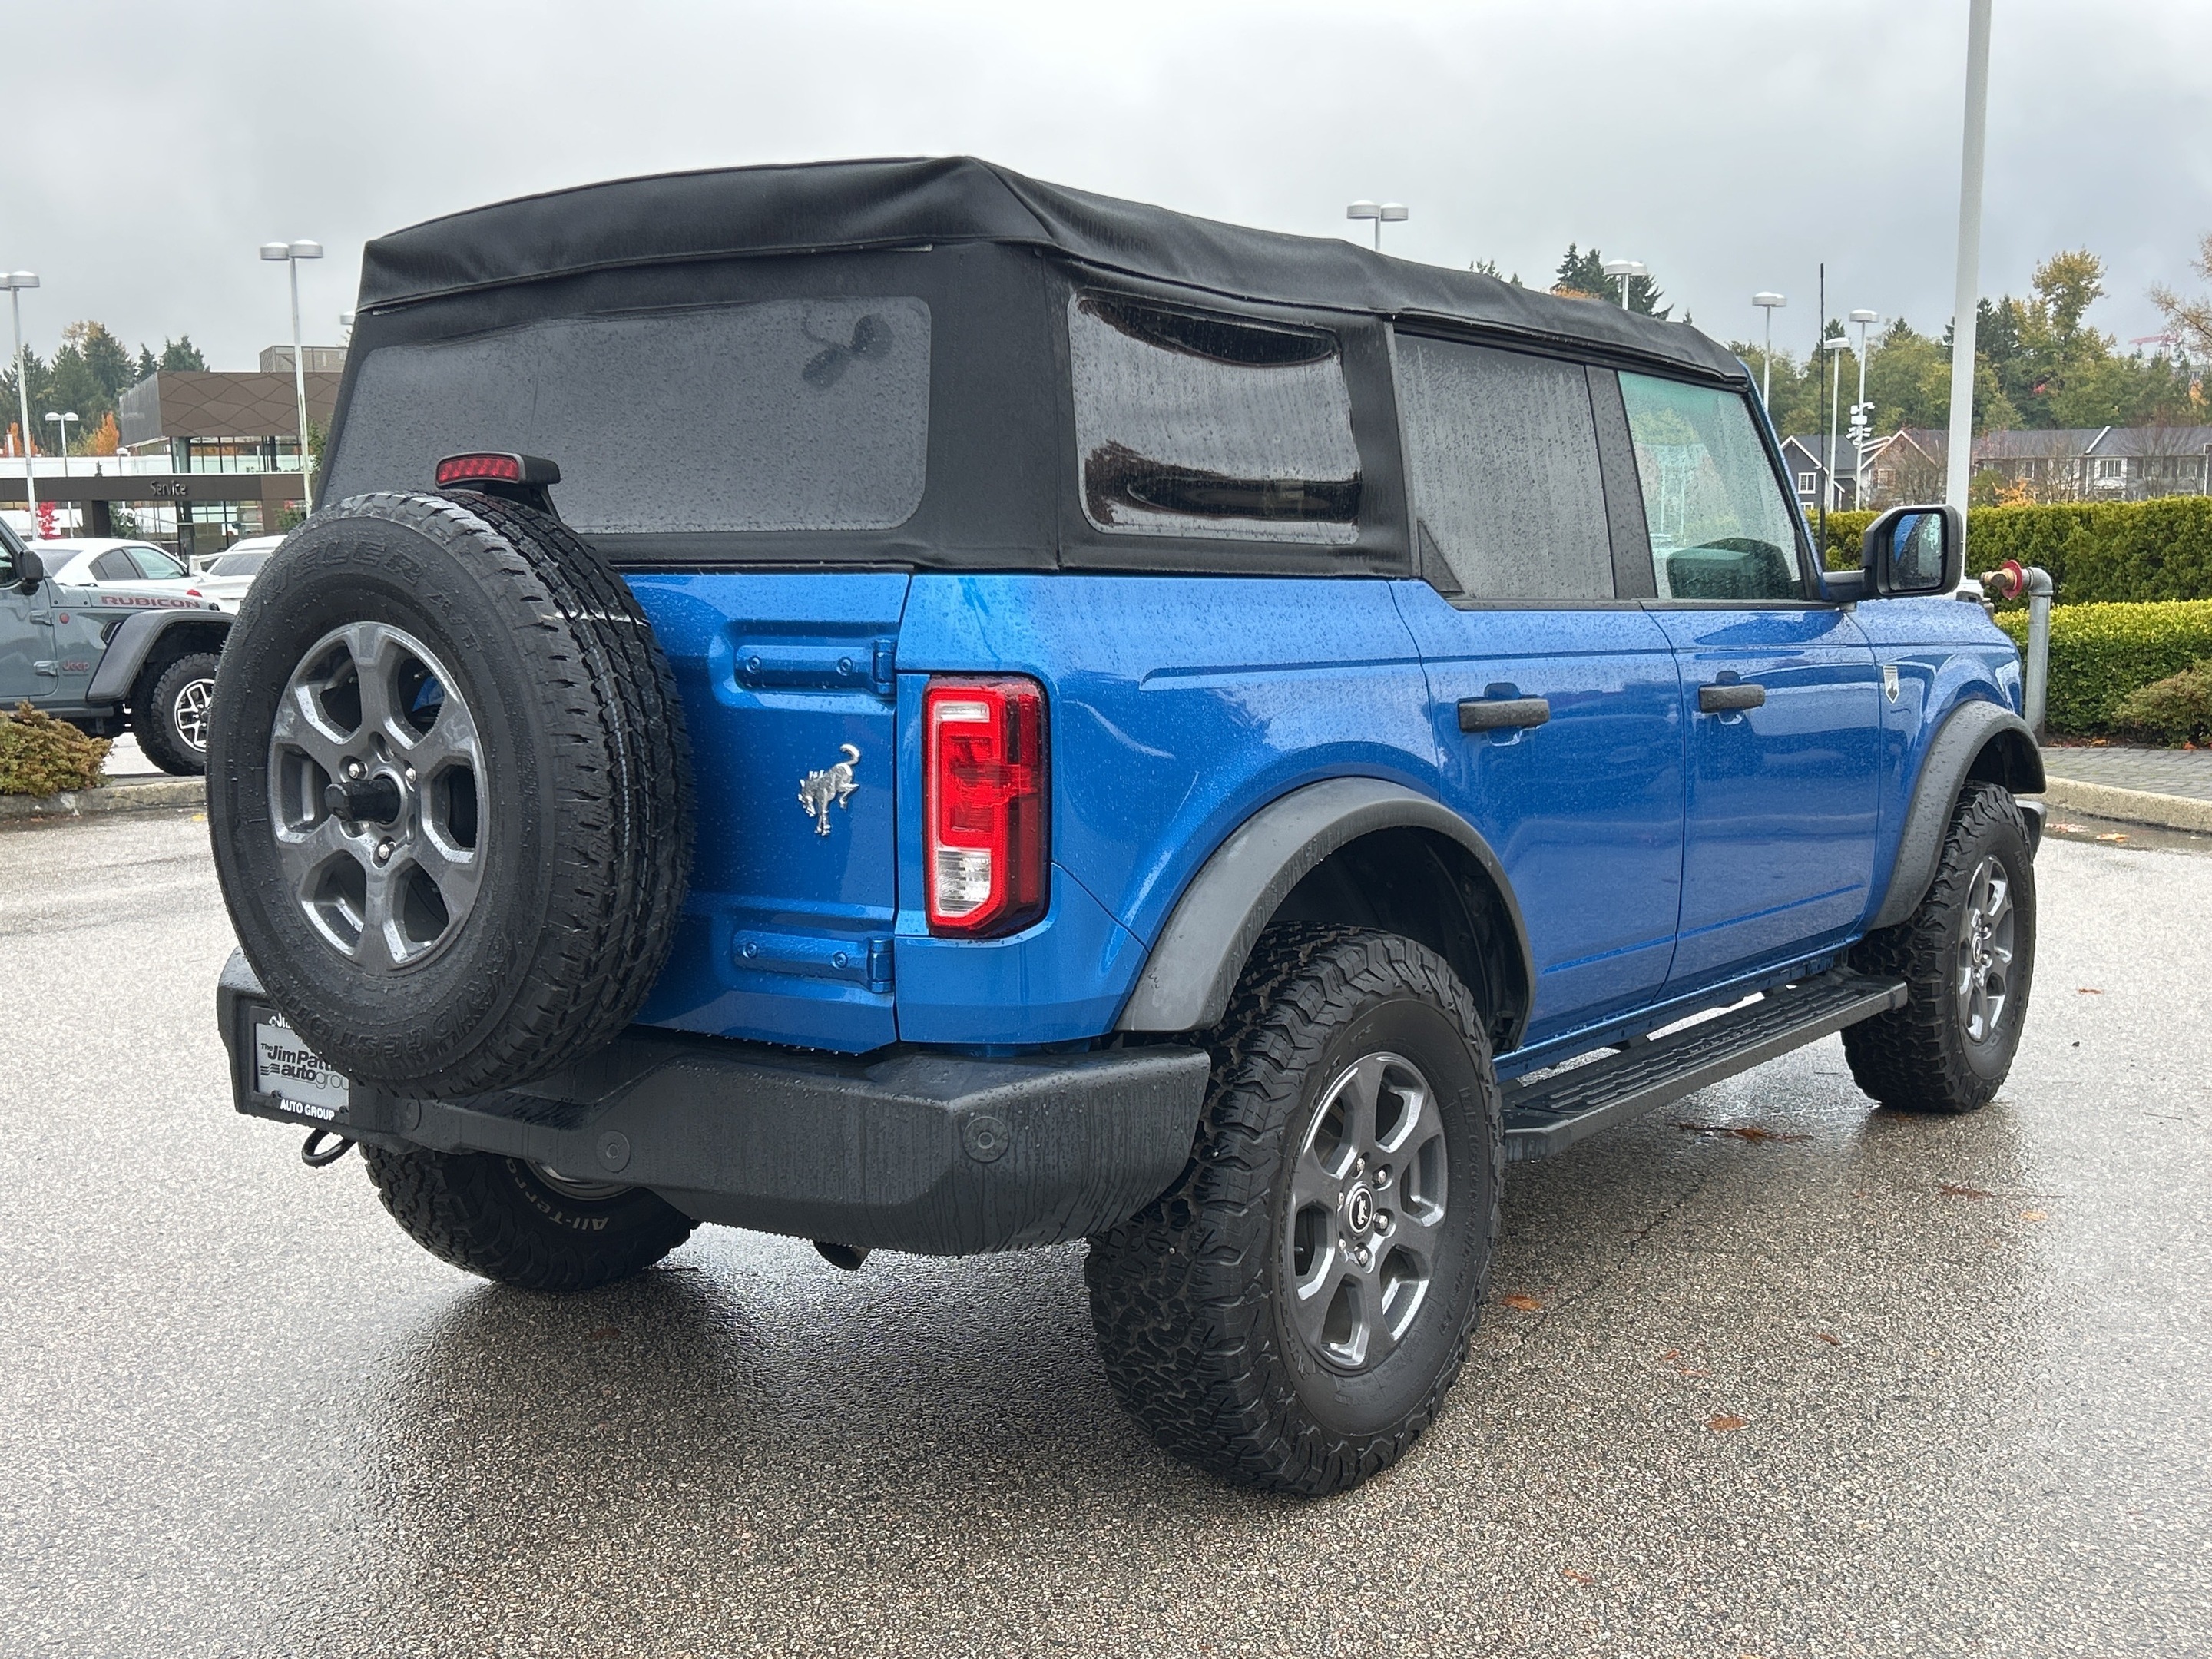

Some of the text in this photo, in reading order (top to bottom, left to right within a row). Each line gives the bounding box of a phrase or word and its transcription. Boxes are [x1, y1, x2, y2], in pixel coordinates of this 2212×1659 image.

[150, 480, 187, 495] Service
[101, 596, 200, 608] RUBICON
[63, 660, 89, 672] Jeep
[261, 1043, 273, 1051] The
[280, 1098, 335, 1121] AUTO GROUP
